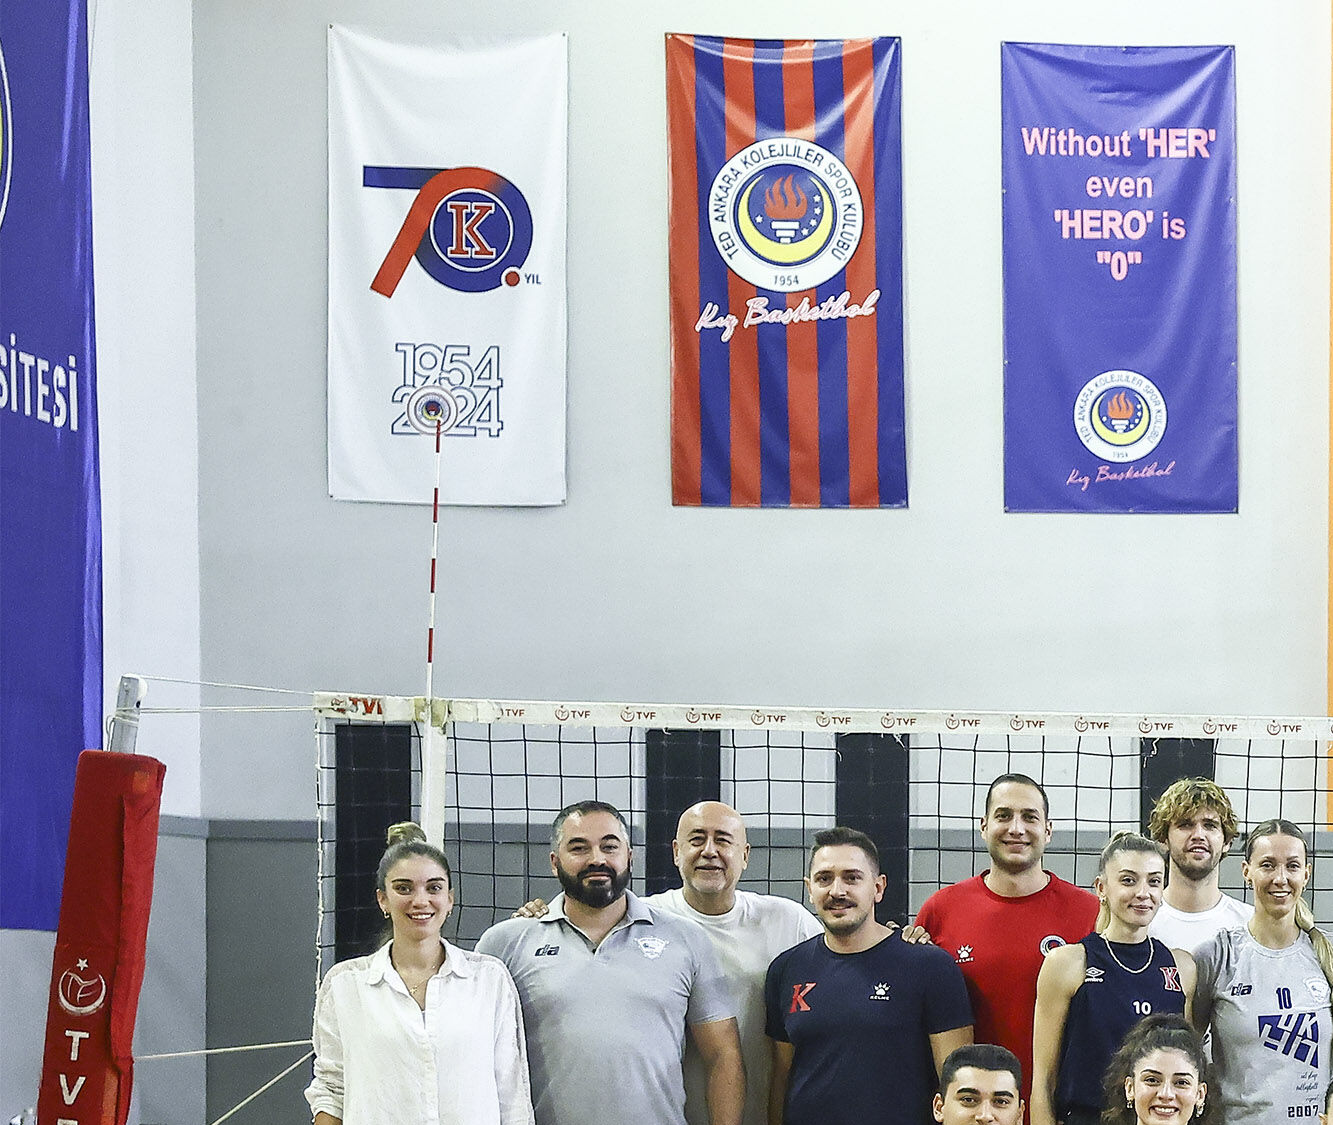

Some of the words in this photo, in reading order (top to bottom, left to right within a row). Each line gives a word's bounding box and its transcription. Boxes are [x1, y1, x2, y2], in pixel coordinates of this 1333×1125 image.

[740, 140, 825, 169] KOLEJLİLER
[1021, 127, 1132, 158] Without
[1139, 127, 1217, 159] 'HER'
[714, 166, 743, 223] ANKARA
[823, 162, 854, 200] SPOR
[1085, 175, 1154, 199] even
[447, 201, 495, 259] K
[831, 202, 858, 263] KULÜBÜ
[1053, 208, 1155, 240] 'HERO'
[1161, 210, 1187, 240] is
[718, 231, 740, 260] TED
[524, 274, 542, 285] YIL
[773, 274, 800, 287] 1954
[742, 289, 882, 330] Basketbol
[395, 343, 503, 388] 1954
[391, 386, 503, 437] 224
[348, 697, 384, 715] TV
[701, 713, 721, 721] TVF
[1026, 720, 1045, 728] TVF
[1162, 966, 1182, 991] K
[789, 982, 816, 1013] K
[1133, 1001, 1151, 1014] 10
[1276, 987, 1292, 1009] 10
[1288, 1105, 1319, 1118] 2007
